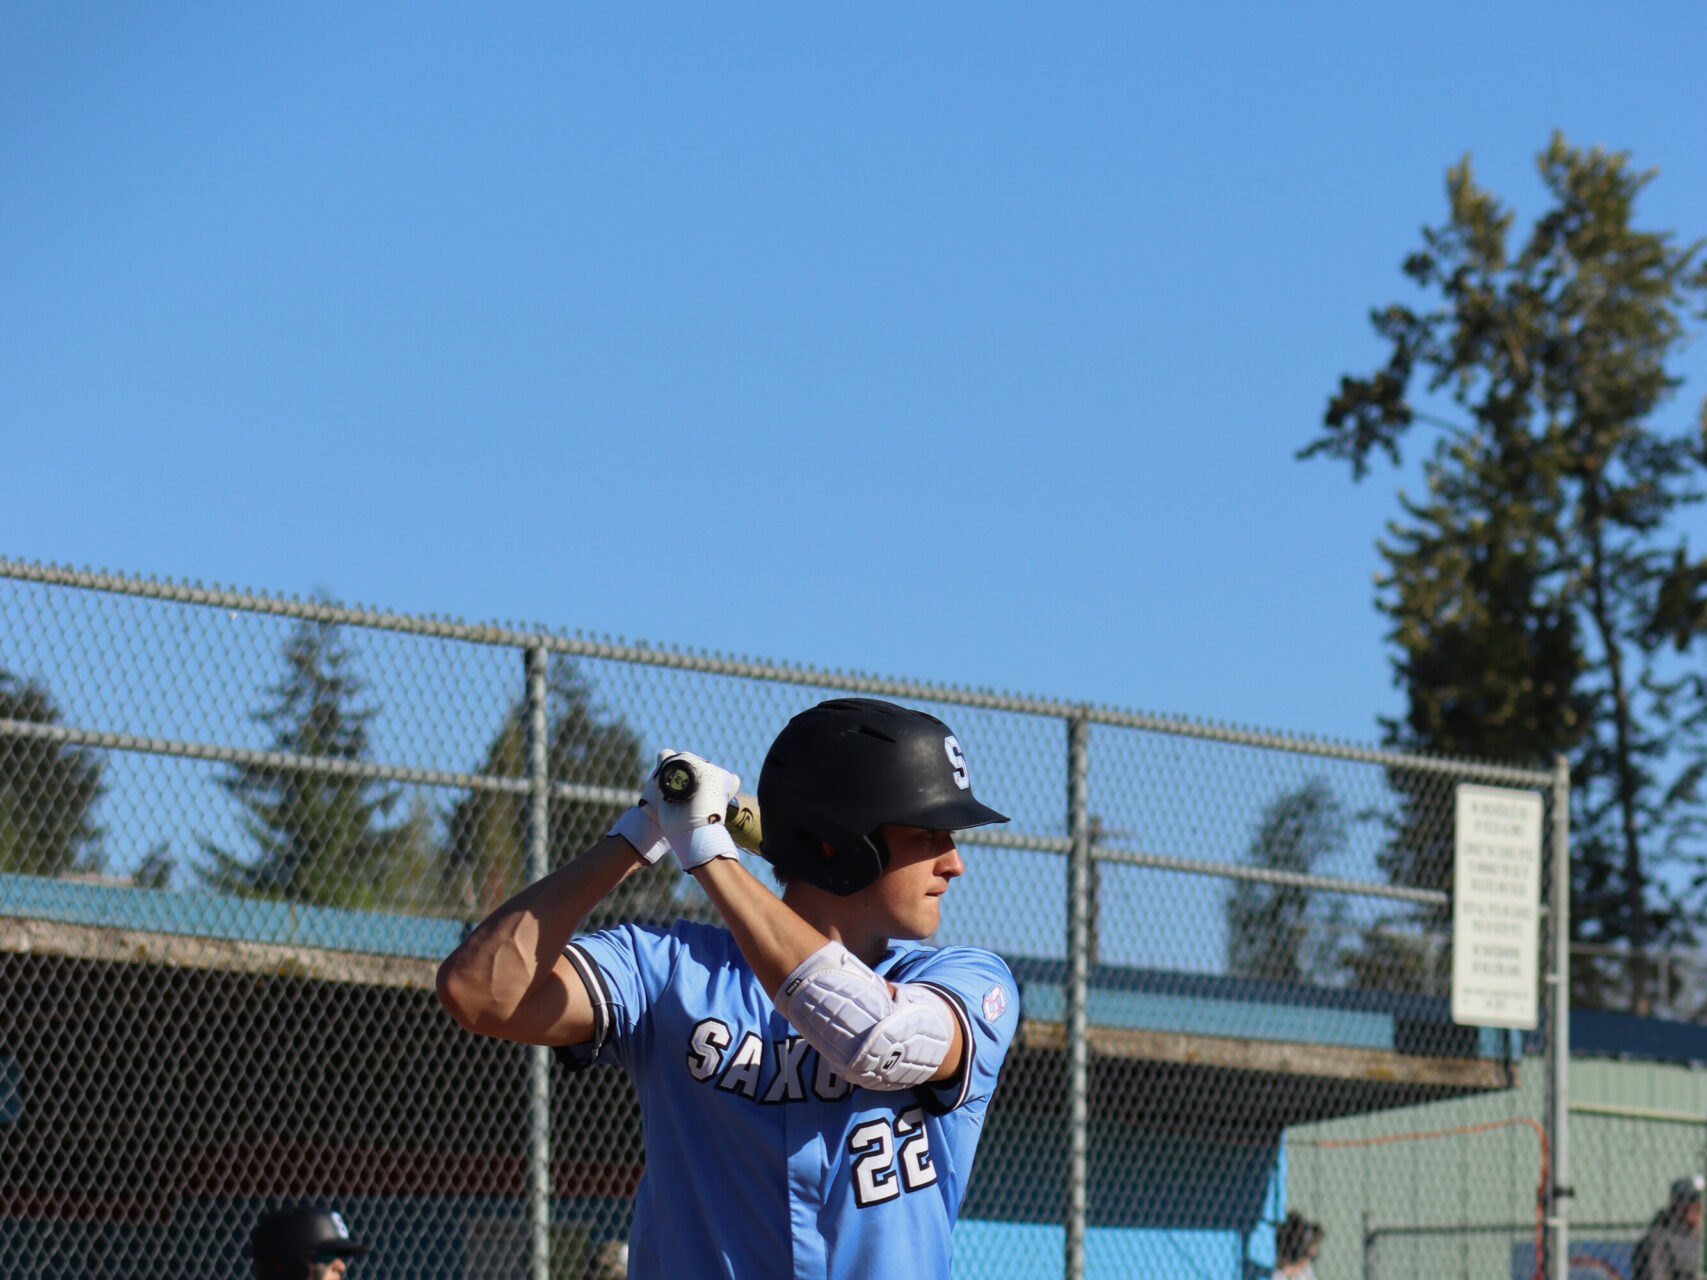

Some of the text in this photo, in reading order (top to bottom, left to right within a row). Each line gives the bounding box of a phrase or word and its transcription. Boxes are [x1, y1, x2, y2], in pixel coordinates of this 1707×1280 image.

[944, 735, 969, 790] S
[687, 1017, 852, 1104] SAXO
[846, 1104, 938, 1209] 22
